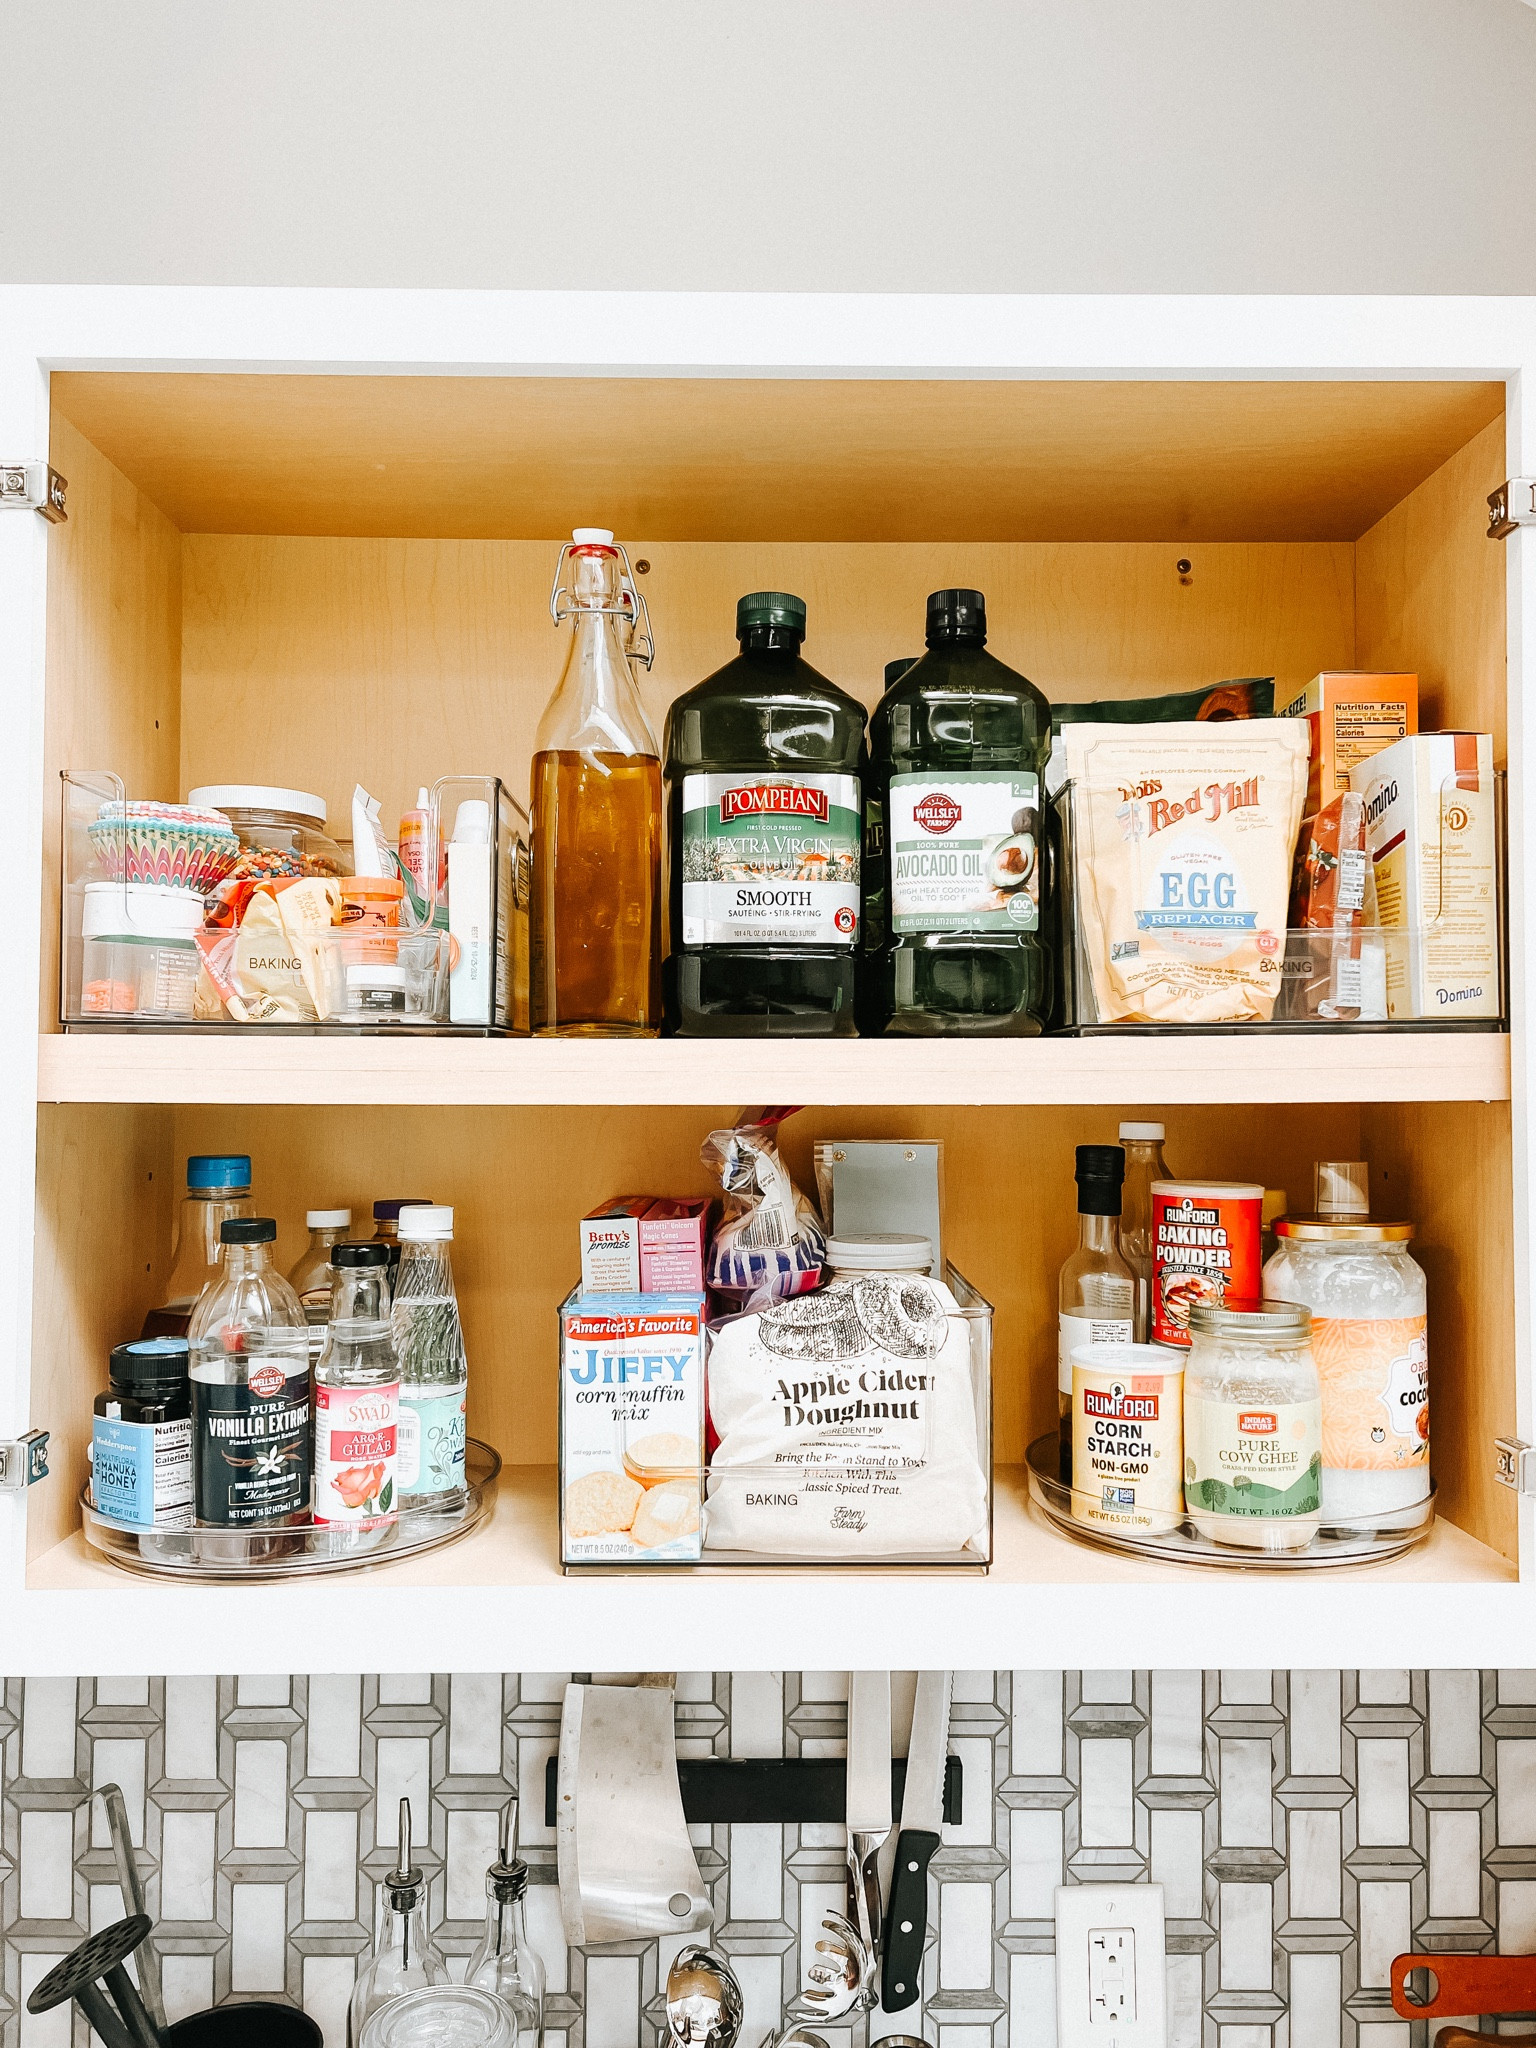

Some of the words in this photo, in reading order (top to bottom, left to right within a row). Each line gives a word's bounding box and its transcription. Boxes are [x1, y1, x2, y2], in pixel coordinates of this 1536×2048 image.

[1398, 727, 1405, 735] 0
[1014, 784, 1020, 795] 2
[728, 789, 821, 813] POMPEIAN
[1147, 788, 1203, 837] Red
[1204, 775, 1261, 823] Mill
[915, 808, 960, 819] WELLSLEY
[716, 836, 770, 854] EXTRA
[773, 835, 833, 854] VIRGIN
[938, 841, 960, 849] PURE
[749, 860, 780, 869] OLIVE
[782, 860, 799, 870] OIL
[897, 854, 958, 879] AVOCADO
[963, 854, 983, 877] OIL
[1160, 872, 1237, 909] EGG
[736, 889, 812, 906] SMOOTH
[728, 908, 767, 917] SAUTÉING
[774, 909, 822, 918] STIR-FRYING
[1151, 914, 1246, 925] REPLACER
[950, 917, 968, 925] LITERS
[1260, 937, 1277, 947] GF
[249, 957, 302, 970] BAKING
[1260, 961, 1312, 973] BAKING
[1194, 965, 1223, 974] BAKING
[1224, 968, 1250, 977] NEEDS
[1215, 974, 1238, 982] QUICK
[1436, 985, 1483, 1005] Domino
[1166, 1208, 1218, 1224] RUMFORD
[589, 1230, 630, 1243] Betty's
[643, 1232, 660, 1241] Magic
[1158, 1224, 1227, 1247] BAKING
[587, 1241, 631, 1254] promise
[1157, 1244, 1232, 1268] POWDER
[1162, 1264, 1184, 1274] TRUSTED
[1185, 1266, 1204, 1275] SINCE
[569, 1317, 635, 1334] America's
[637, 1317, 693, 1332] Favorite
[1163, 1329, 1173, 1337] NET
[1173, 1329, 1182, 1338] WT
[251, 1375, 284, 1387] WELLSLEY
[771, 1374, 850, 1404] Apple
[576, 1391, 617, 1404] corn
[249, 1401, 285, 1415] PURE
[348, 1403, 390, 1422] SWAD
[783, 1399, 920, 1426] Doughnut
[1087, 1394, 1155, 1418] RUMFORD
[611, 1404, 650, 1422] mix
[208, 1416, 265, 1437] VANILLA
[268, 1403, 309, 1434] EXTRACT
[1244, 1416, 1272, 1424] INDIA'S
[819, 1426, 867, 1435] INGREDIENT
[1095, 1421, 1142, 1439] CORN
[1241, 1423, 1273, 1431] NATURE
[251, 1434, 281, 1444] Gourmet
[281, 1429, 300, 1439] Extract
[96, 1436, 137, 1452] Wedderspoon
[155, 1440, 175, 1448] Serving
[342, 1440, 392, 1456] GULAB
[1087, 1437, 1152, 1457] STARCH
[1238, 1440, 1281, 1452] PURE
[101, 1453, 137, 1467] MULTIFLORAL
[155, 1453, 190, 1464] Calories
[775, 1453, 804, 1464] Bring
[806, 1452, 822, 1462] the
[855, 1455, 885, 1466] Stand
[888, 1456, 899, 1466] to
[1219, 1450, 1254, 1463] COW
[1258, 1451, 1299, 1464] GHEE
[101, 1462, 137, 1477] MANUKA
[1091, 1457, 1149, 1474] NON-GMO
[1222, 1464, 1257, 1472] GRASS-FED
[101, 1472, 137, 1490] HONEY
[846, 1469, 872, 1480] With
[875, 1470, 897, 1480] This
[799, 1482, 833, 1493] lassic
[835, 1483, 869, 1495] Spiced
[872, 1484, 902, 1495] Treat.
[746, 1494, 798, 1506] BAKING
[100, 1503, 108, 1511] NET
[108, 1505, 124, 1515] WEIGHT
[228, 1510, 240, 1519] NET
[240, 1509, 257, 1518] CONT
[258, 1508, 264, 1516] 16
[265, 1506, 272, 1515] OZ
[834, 1506, 865, 1520] Farm
[1229, 1506, 1247, 1515] NET
[1271, 1508, 1280, 1516] 16
[1281, 1507, 1293, 1515] OZ
[1088, 1509, 1100, 1519] NET
[1100, 1513, 1109, 1521] WT
[1110, 1514, 1120, 1522] 6.5
[1121, 1516, 1131, 1524] OZ
[1132, 1516, 1153, 1526] (184g)
[830, 1517, 868, 1533] Steady
[571, 1544, 583, 1554] NET
[584, 1544, 594, 1554] WT
[604, 1544, 614, 1554] OZ
